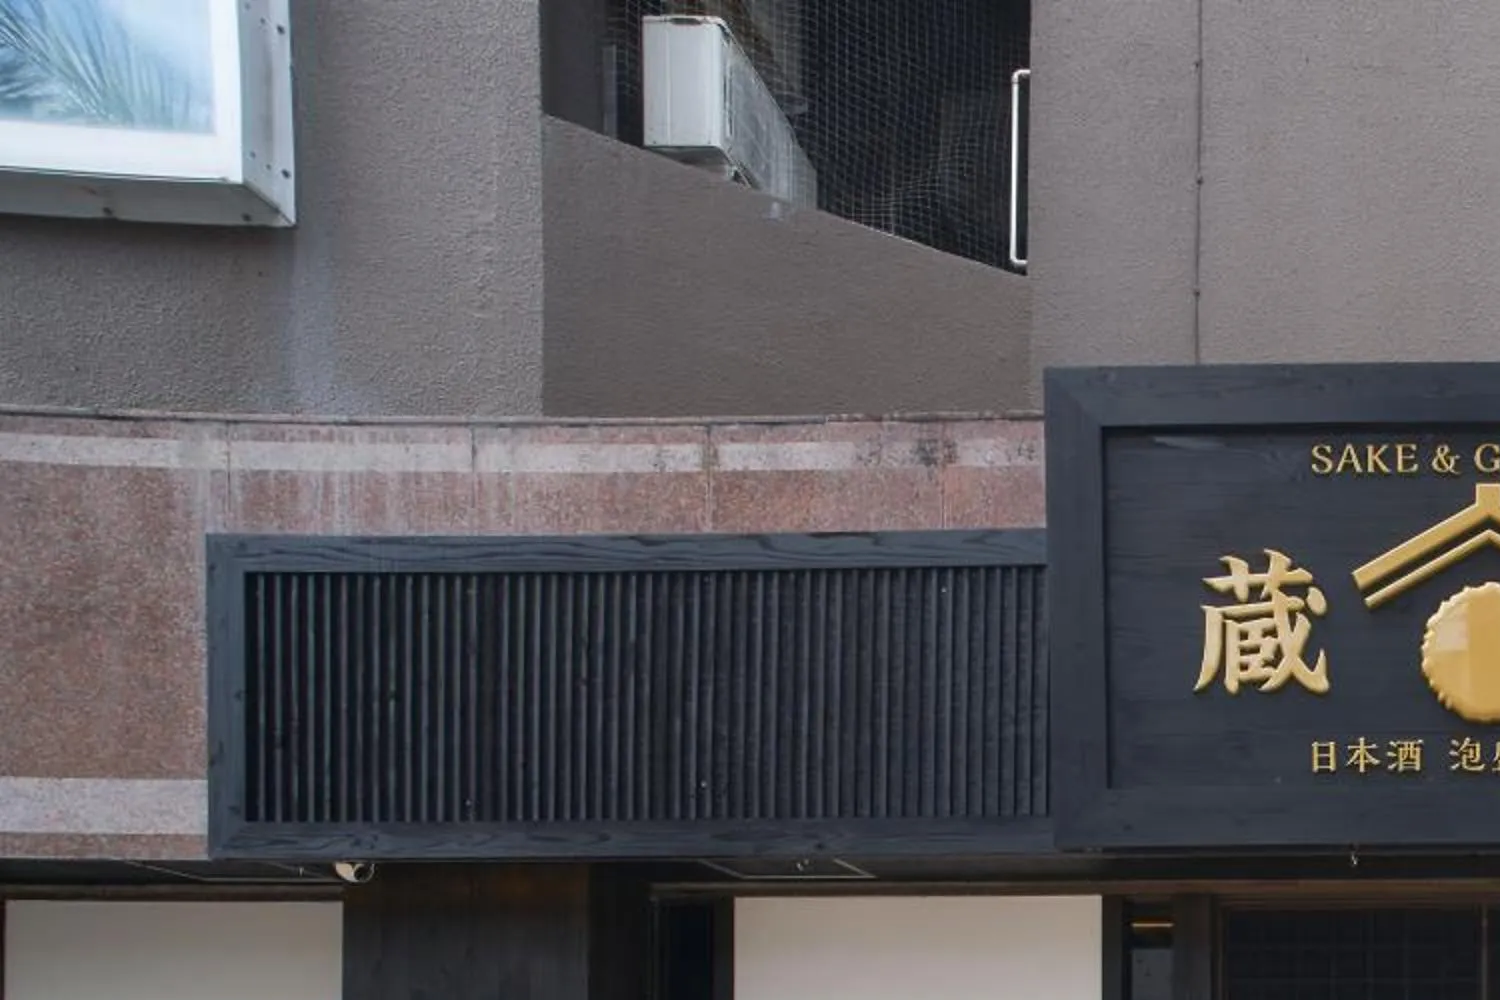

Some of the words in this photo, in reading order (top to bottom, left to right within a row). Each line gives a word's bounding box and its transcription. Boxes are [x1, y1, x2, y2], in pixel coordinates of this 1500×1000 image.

[1310, 442, 1418, 476] SAKE
[1431, 445, 1461, 475] &
[1310, 736, 1424, 774] 日本酒
